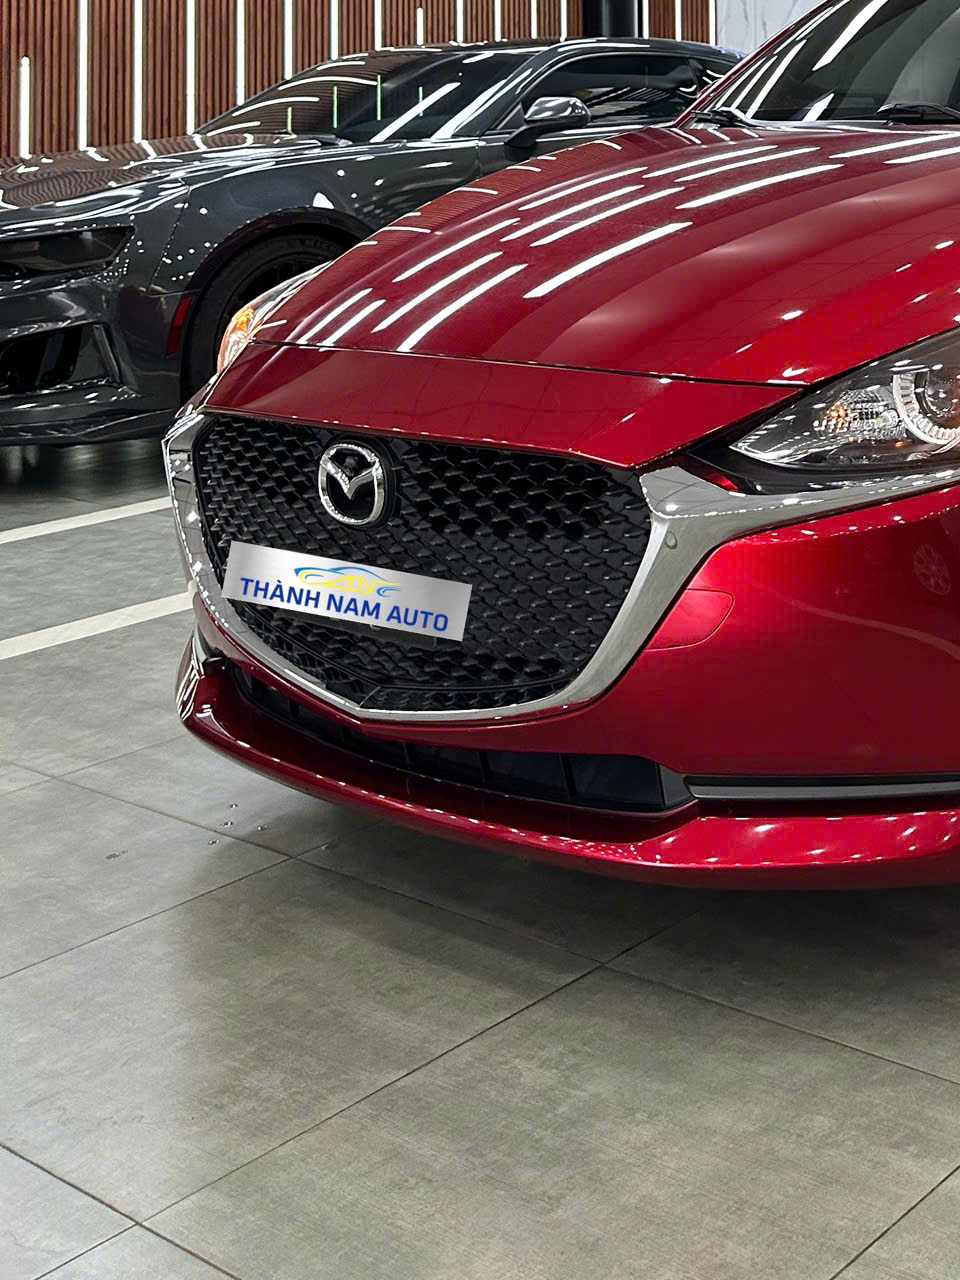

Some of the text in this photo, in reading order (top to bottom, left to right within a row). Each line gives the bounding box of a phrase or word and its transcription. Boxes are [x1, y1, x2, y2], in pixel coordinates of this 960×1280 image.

[240, 577, 449, 632] THÀNH NAM AUTO
